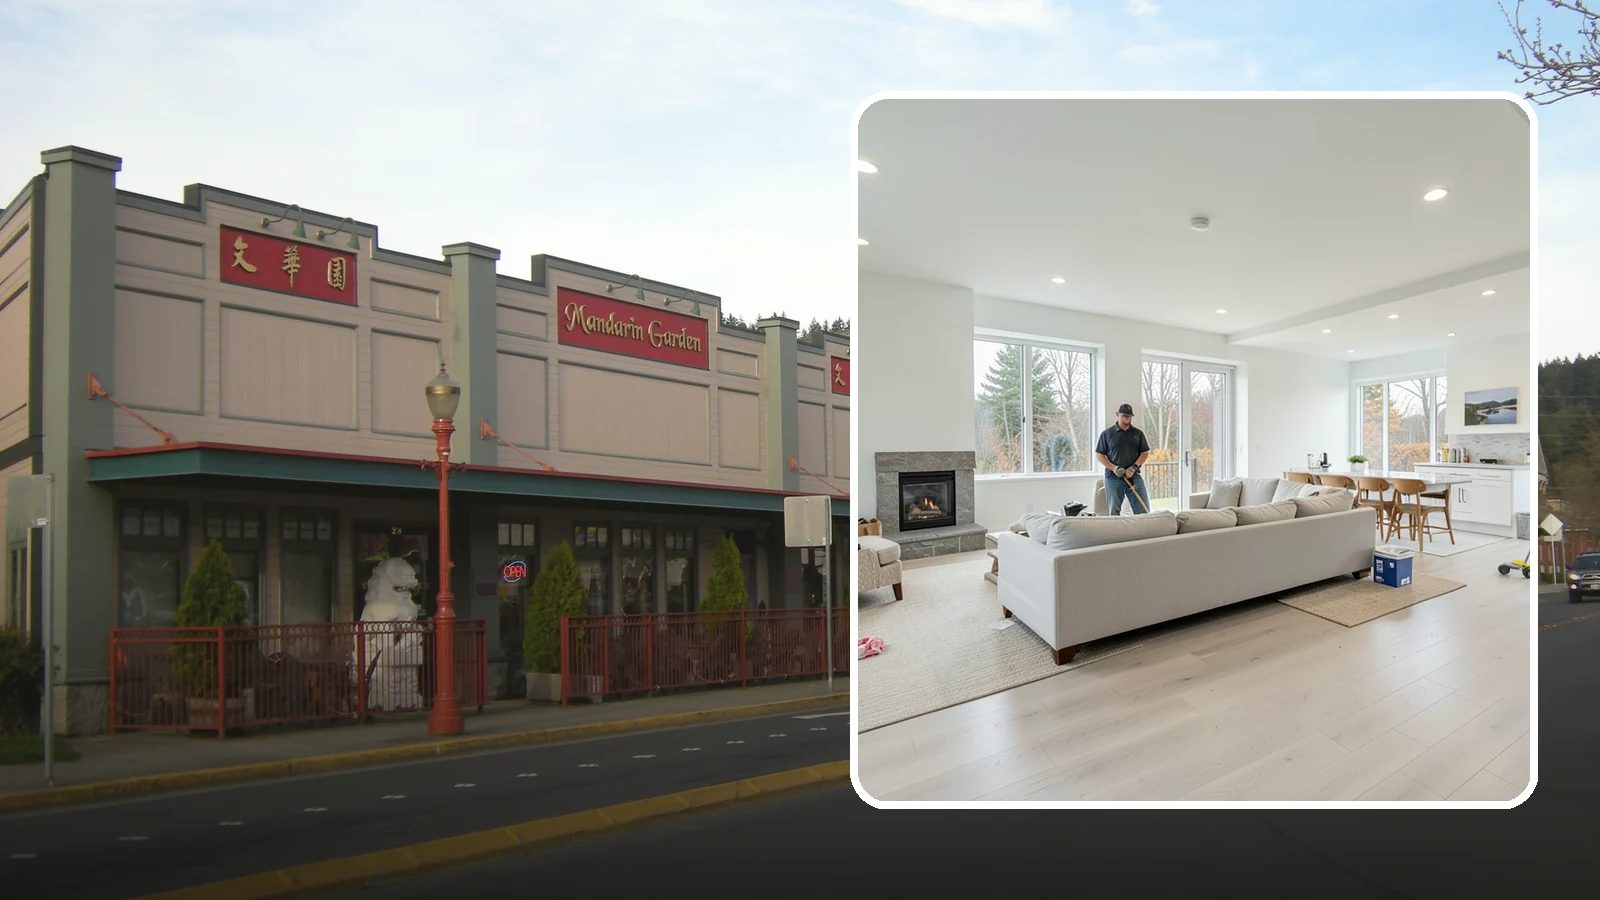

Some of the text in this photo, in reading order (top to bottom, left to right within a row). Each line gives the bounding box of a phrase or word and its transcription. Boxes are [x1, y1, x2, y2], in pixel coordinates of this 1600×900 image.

[230, 235, 346, 291] 文華園
[564, 302, 702, 352] Mandarin Garden
[834, 363, 846, 386] 文
[503, 565, 527, 578] OPEN
